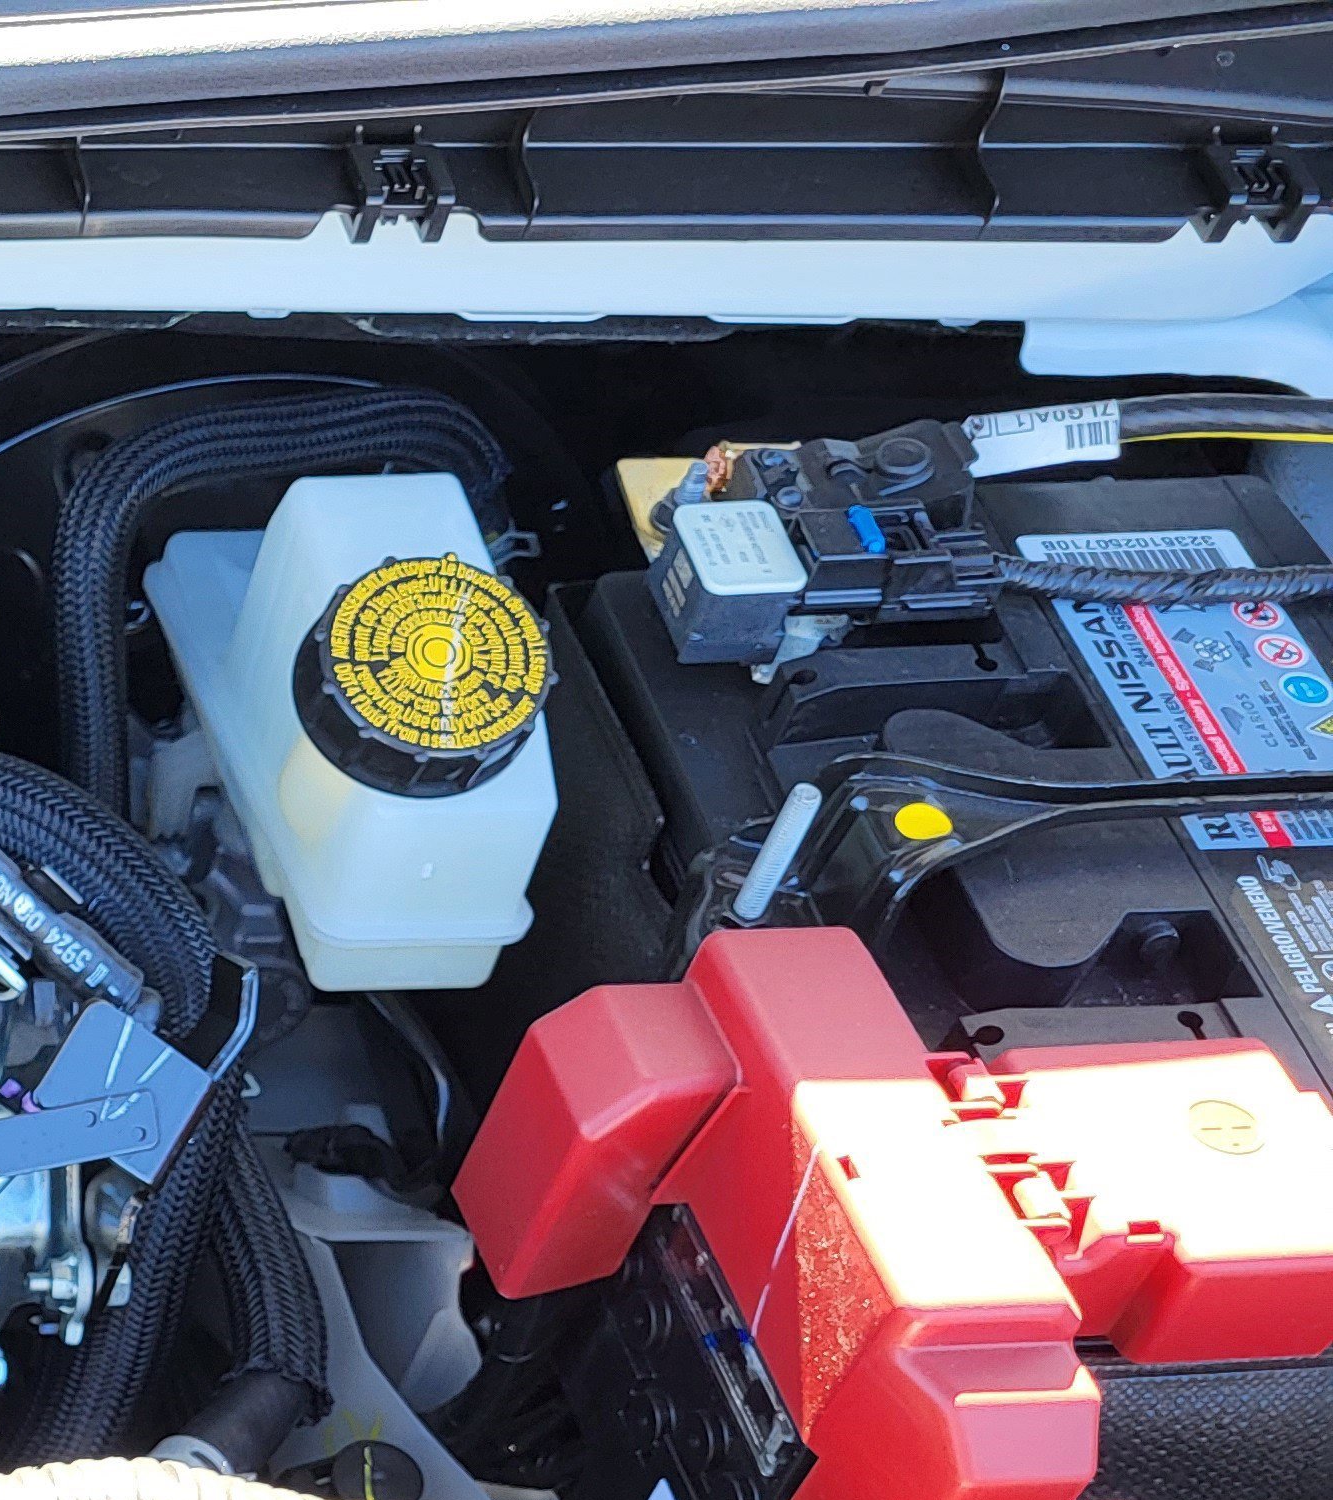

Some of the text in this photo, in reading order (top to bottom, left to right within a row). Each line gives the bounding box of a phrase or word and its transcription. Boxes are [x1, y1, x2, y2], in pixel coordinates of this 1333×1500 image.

[1233, 692, 1281, 747] CLARIOS
[41, 925, 93, 975] 5924
[1236, 874, 1325, 994] PELIGRO/VENENO
